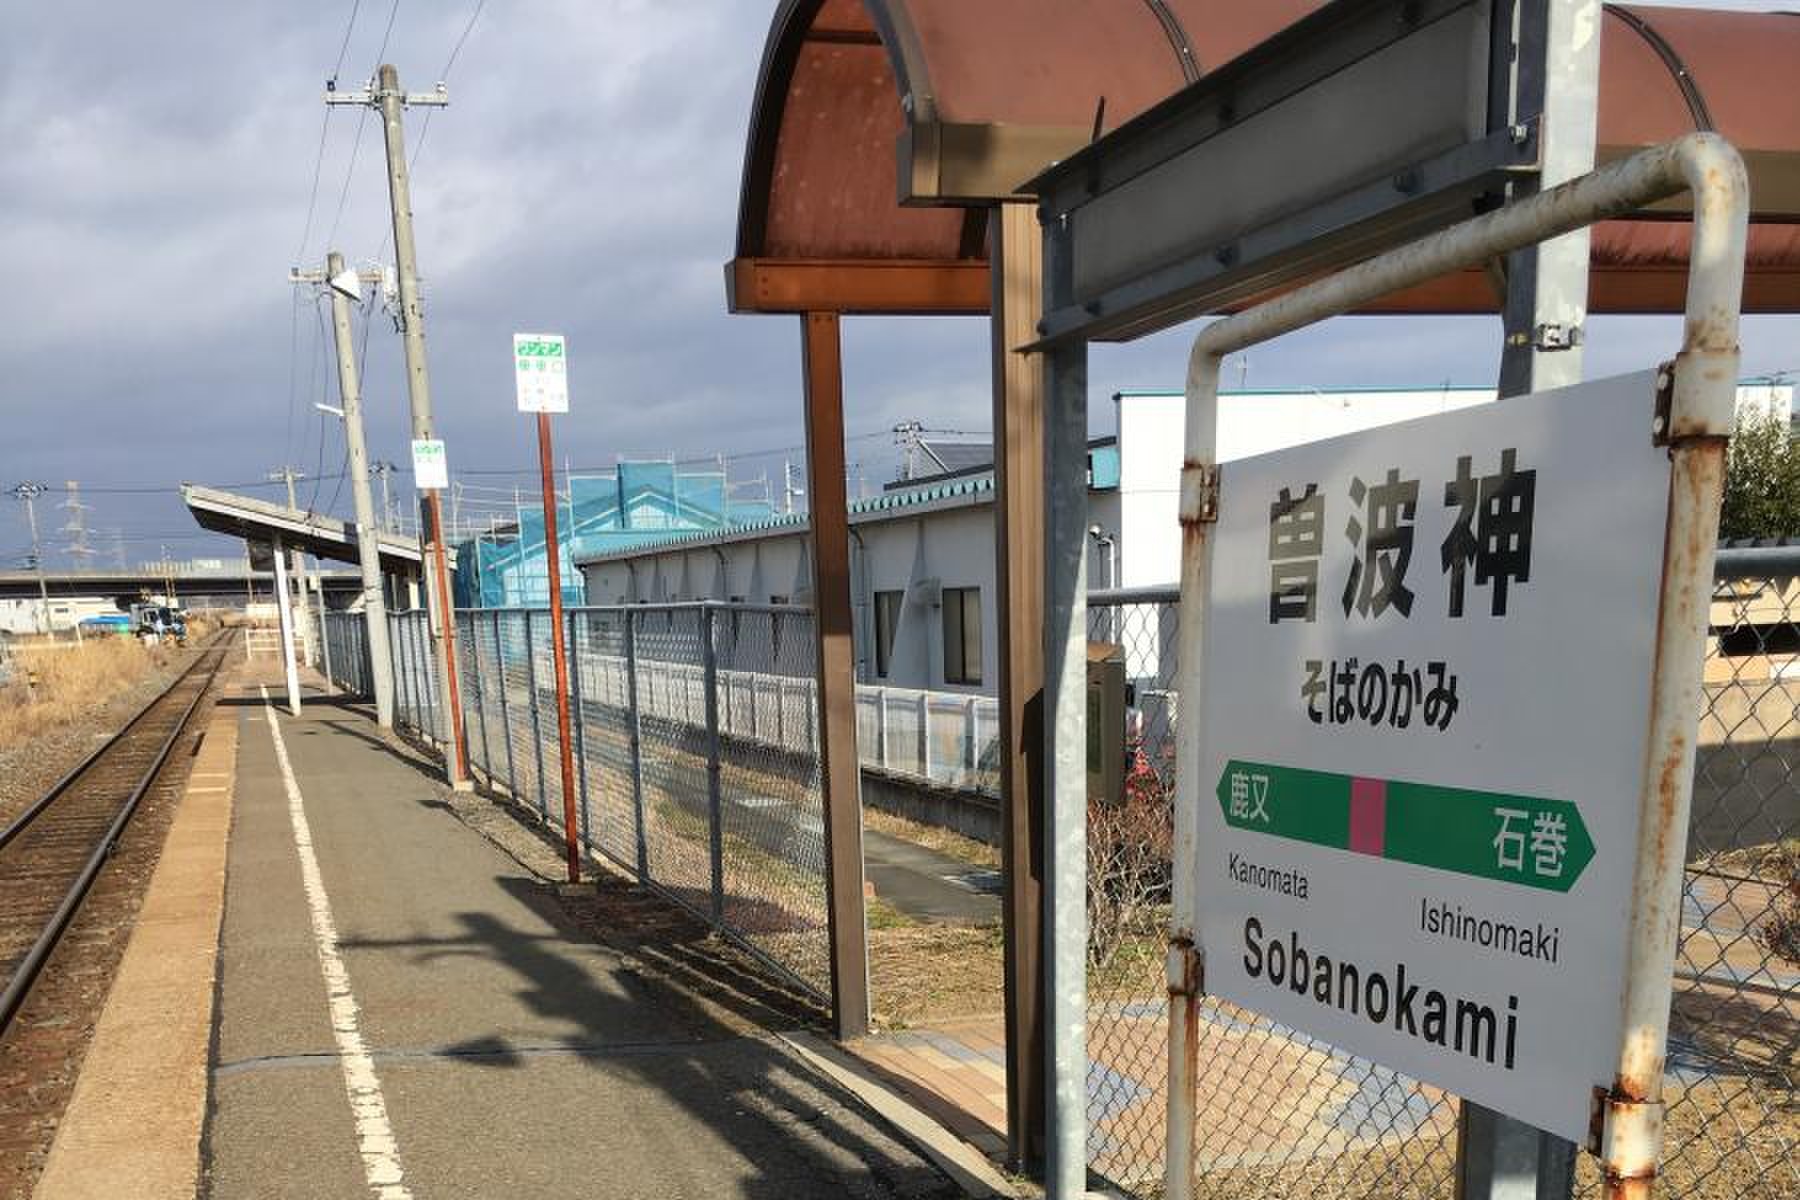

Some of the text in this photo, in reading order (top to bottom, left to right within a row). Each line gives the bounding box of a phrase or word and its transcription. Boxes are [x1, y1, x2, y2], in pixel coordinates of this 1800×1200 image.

[1269, 449, 1536, 624] 曽波神
[1301, 657, 1459, 731] そばのかみ
[1229, 770, 1271, 823] 鹿又
[1229, 853, 1309, 900] Kanomata
[1492, 806, 1567, 877] 石巻
[1421, 898, 1560, 964] Ishinomaki
[1243, 917, 1519, 1070] Sobanokami
